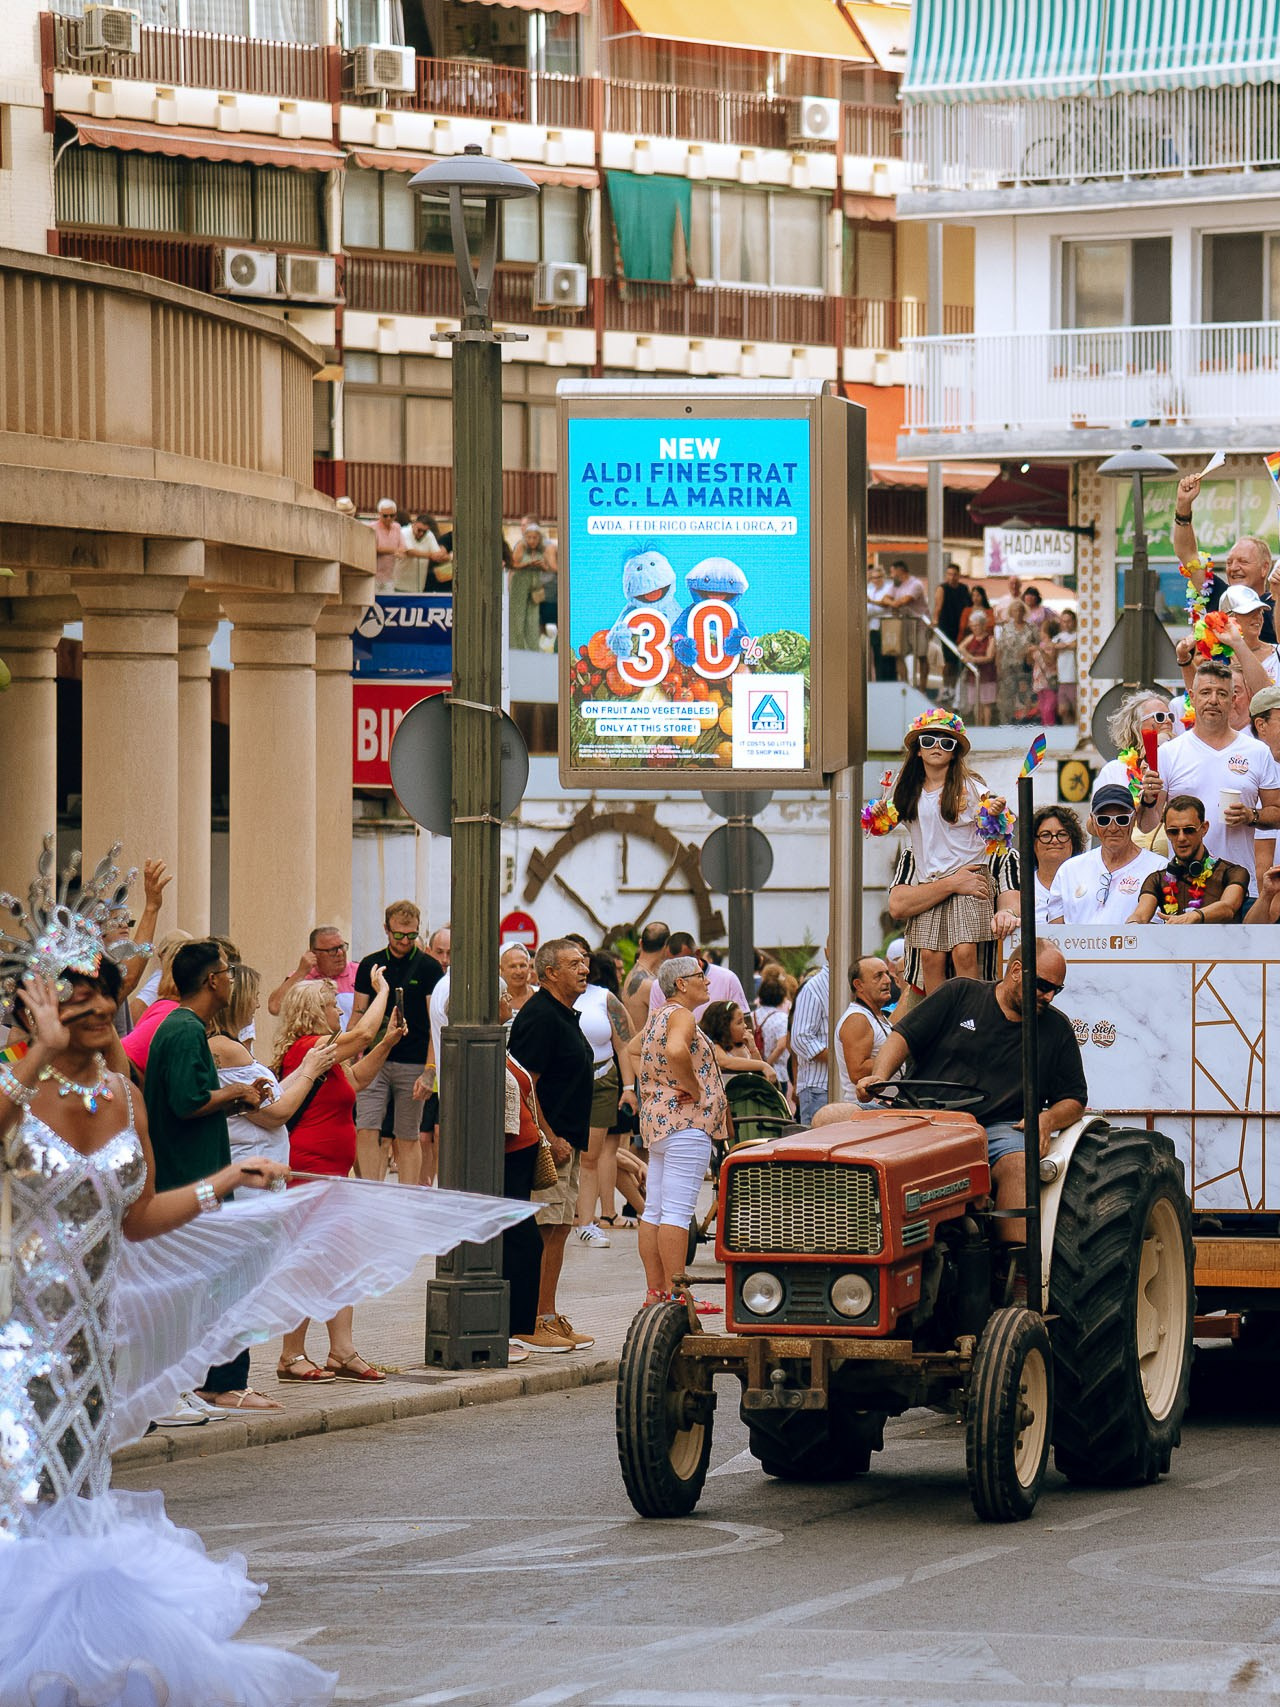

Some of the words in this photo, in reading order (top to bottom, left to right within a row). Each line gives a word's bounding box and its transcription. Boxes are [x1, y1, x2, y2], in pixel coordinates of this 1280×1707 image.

[660, 437, 721, 460] NEW
[581, 462, 641, 483] ALDI
[651, 462, 798, 483] FINESTRAT
[588, 487, 638, 507] C.C.
[646, 487, 679, 507] LA
[688, 487, 792, 508] MARINA
[591, 520, 626, 532] AVDA.
[629, 520, 687, 532] FEDERICO
[690, 517, 734, 532] GARCÍA
[736, 520, 778, 533] LORCA,
[780, 521, 793, 532] 21
[1004, 534, 1072, 555] HADAMAS
[617, 599, 740, 687] 30
[586, 706, 599, 715] ON
[602, 706, 628, 715] FRUIT
[630, 706, 650, 715] AND
[652, 705, 714, 715] VEGETABLES!
[600, 724, 624, 733] ONLY
[627, 724, 640, 732] AT
[641, 724, 661, 732] THIS
[664, 724, 697, 732] STORE!
[752, 721, 784, 730] ALDI
[1064, 938, 1108, 950] events
